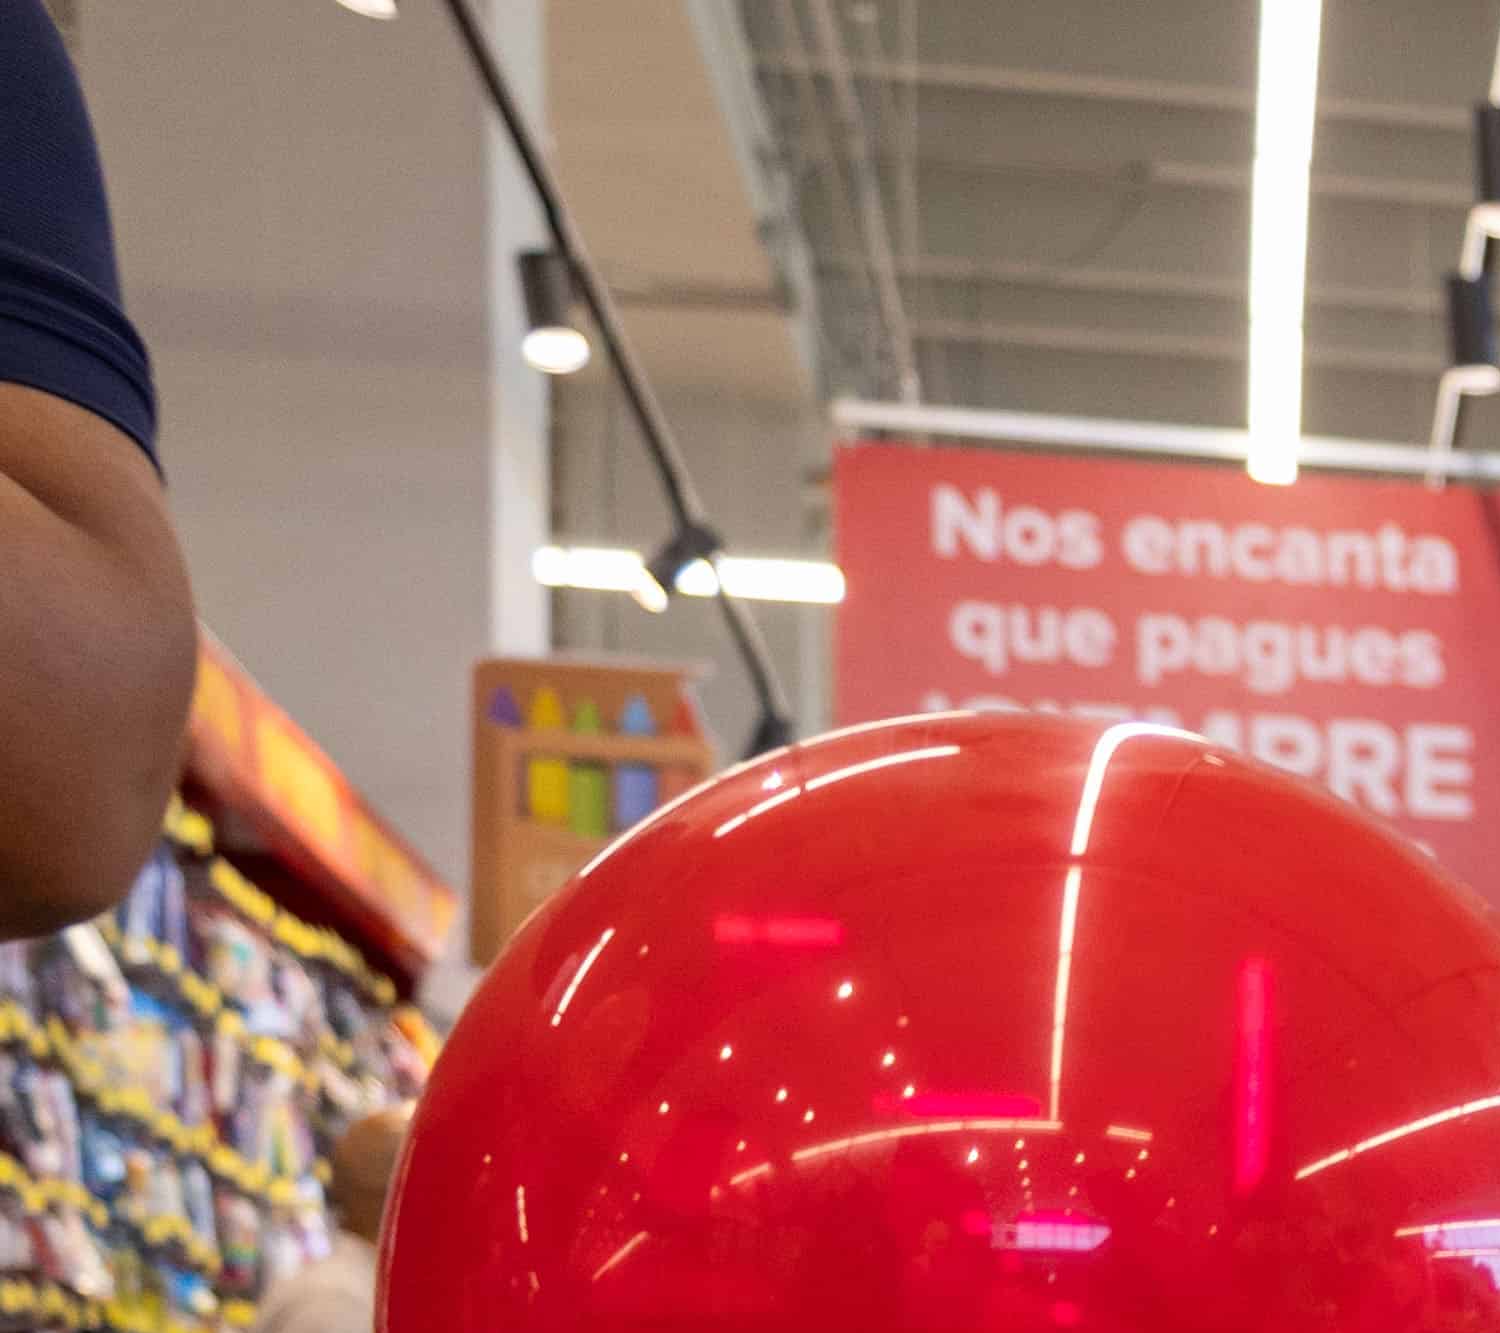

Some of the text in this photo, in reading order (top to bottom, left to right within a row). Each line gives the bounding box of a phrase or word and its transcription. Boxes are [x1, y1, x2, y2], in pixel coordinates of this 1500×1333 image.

[928, 484, 1459, 593] Nos encanta
[948, 600, 1446, 694] que pagues
